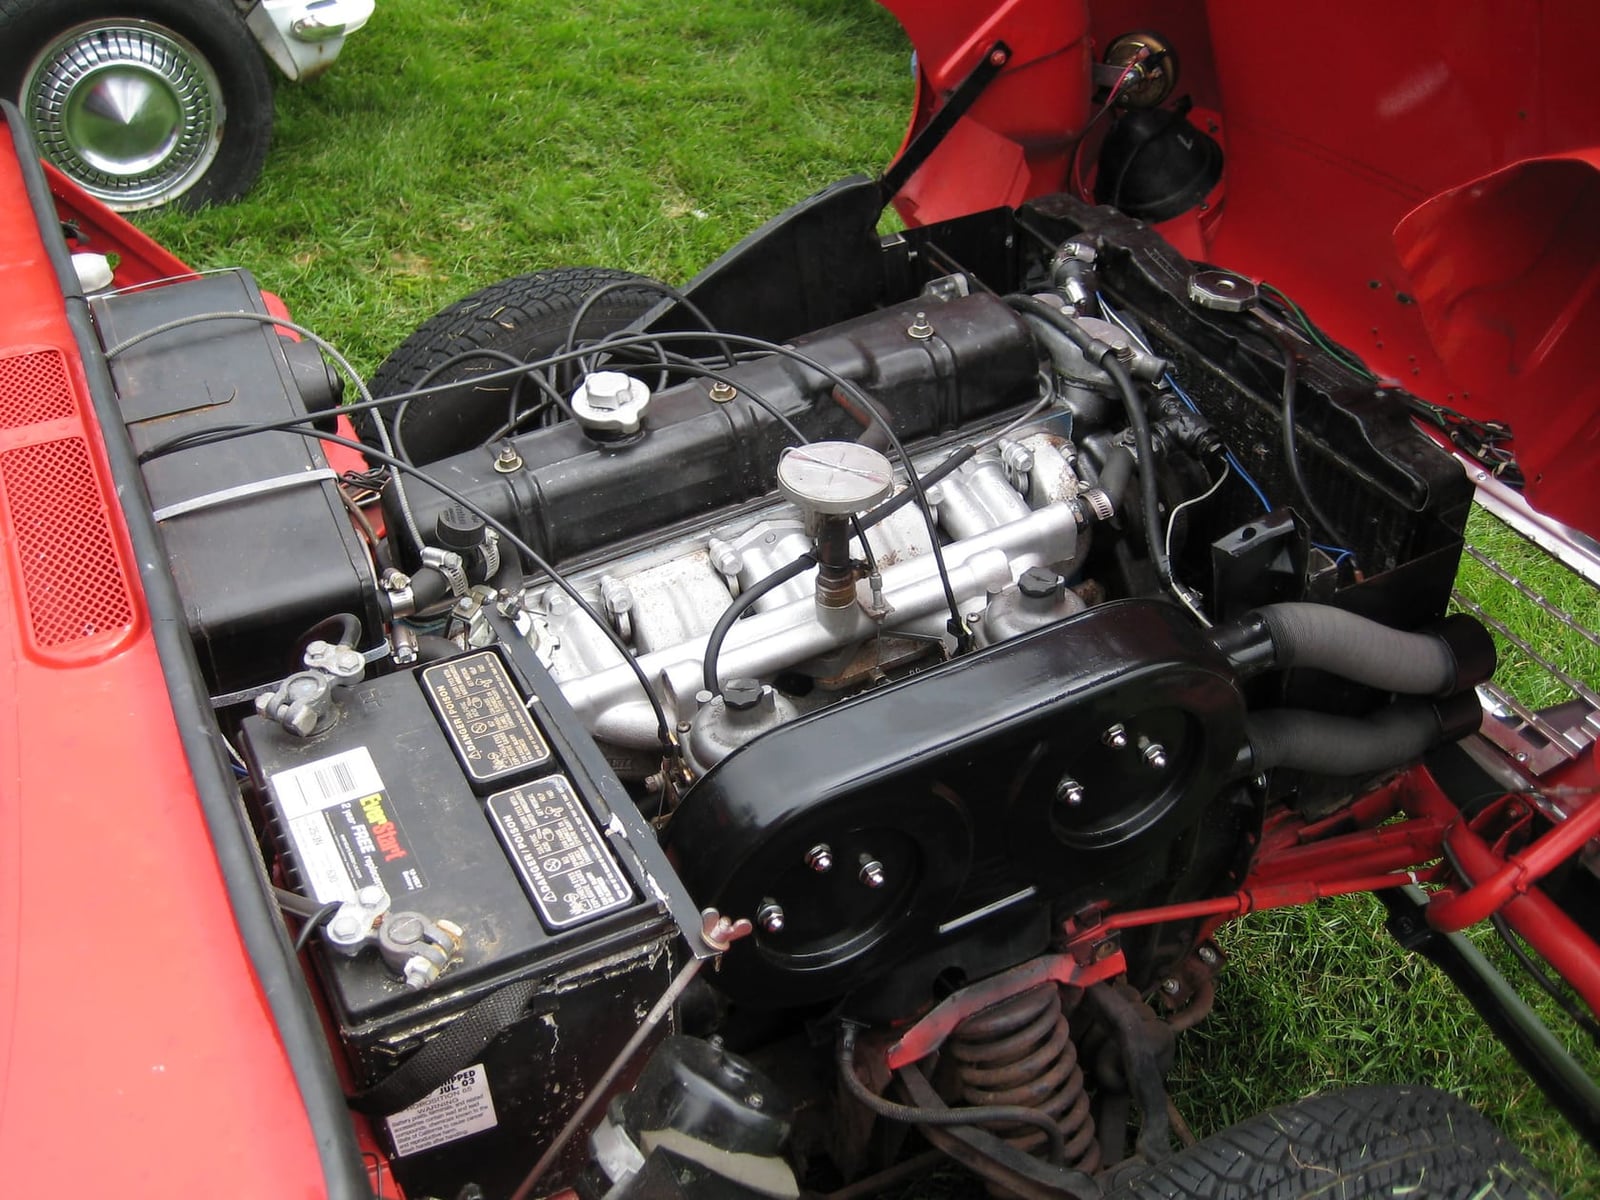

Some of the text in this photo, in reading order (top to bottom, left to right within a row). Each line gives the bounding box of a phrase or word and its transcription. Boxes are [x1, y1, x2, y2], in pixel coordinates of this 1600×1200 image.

[340, 801, 351, 809] 2
[350, 823, 375, 854] FREE
[358, 792, 407, 861] EverStart
[461, 1076, 475, 1087] 03
